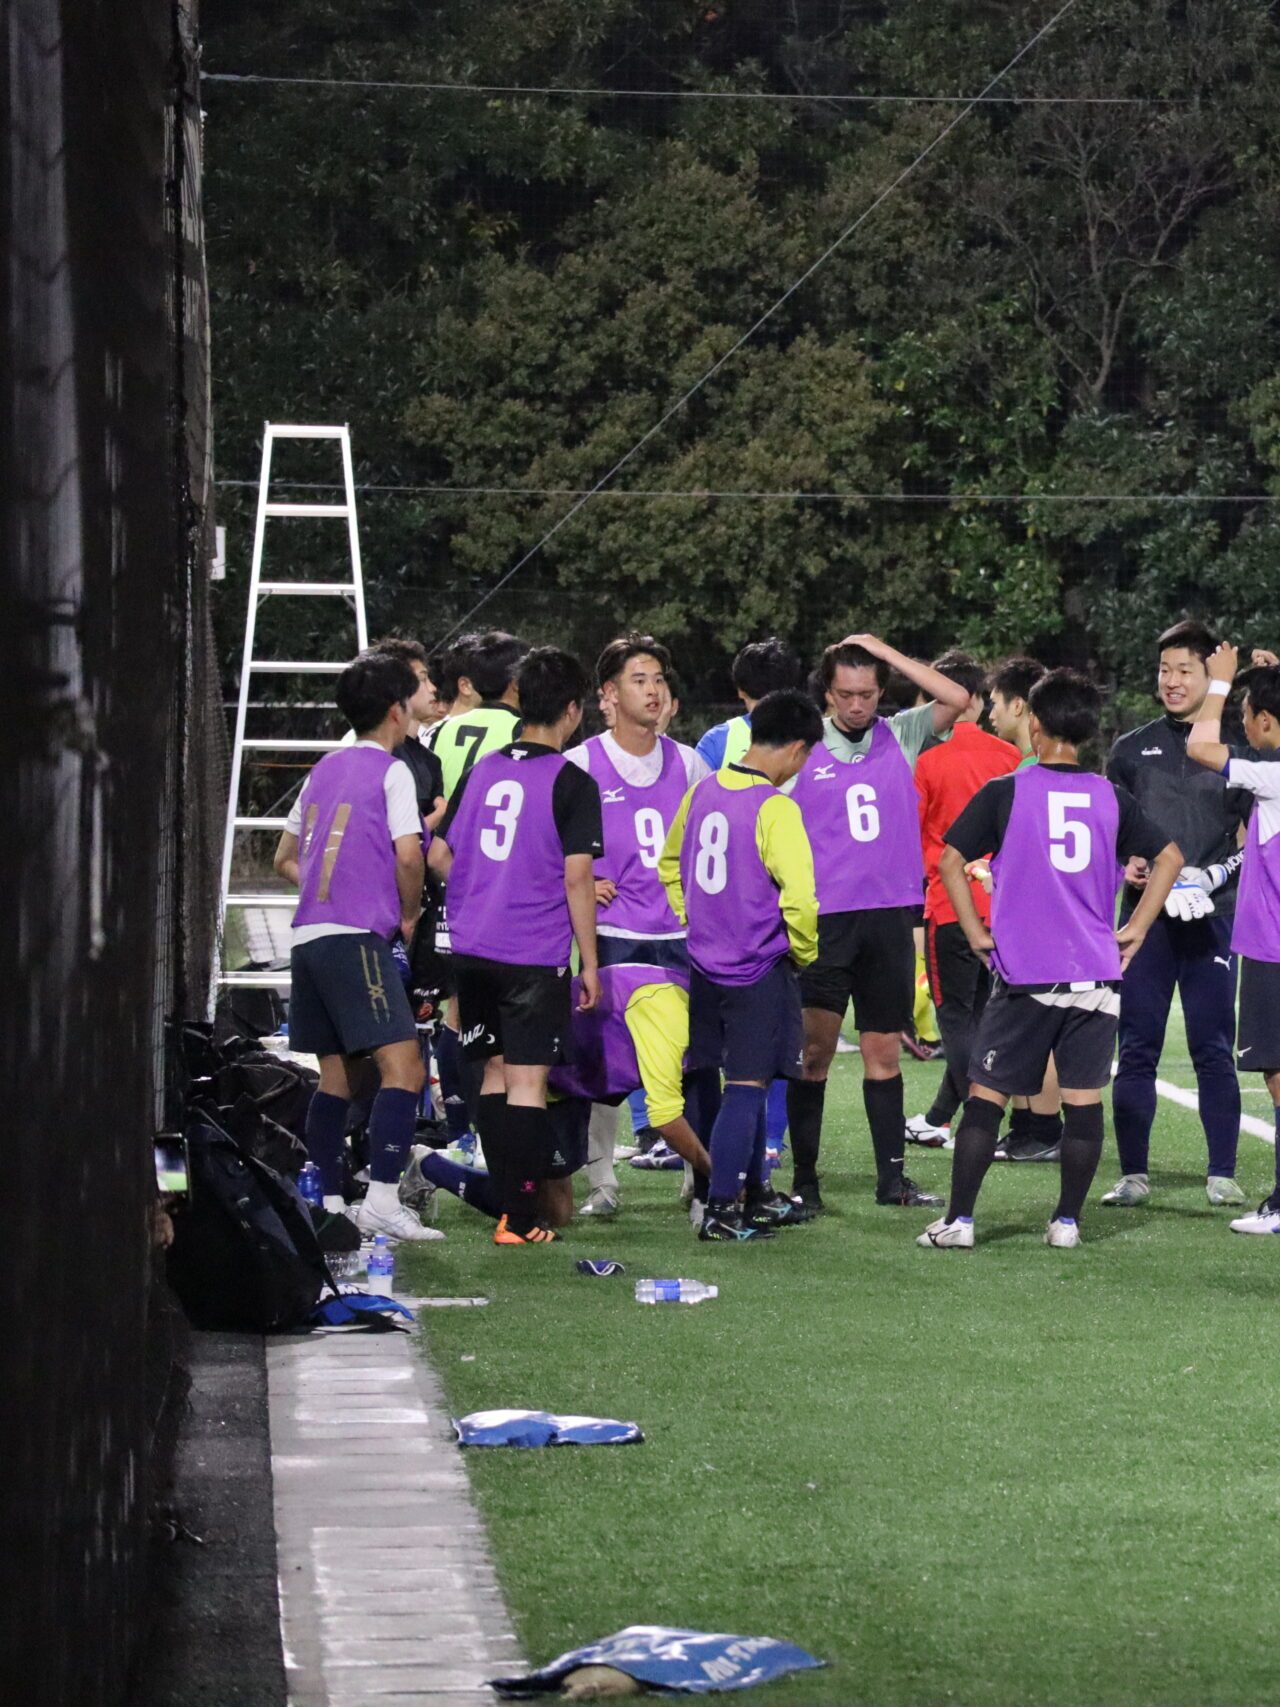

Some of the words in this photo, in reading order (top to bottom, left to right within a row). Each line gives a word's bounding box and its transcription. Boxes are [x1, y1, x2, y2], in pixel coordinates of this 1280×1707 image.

[455, 724, 488, 773] 7
[480, 779, 524, 862] 3
[634, 807, 665, 869] 9
[845, 783, 880, 842] 6
[1047, 790, 1091, 873] 5
[695, 811, 729, 895] 8
